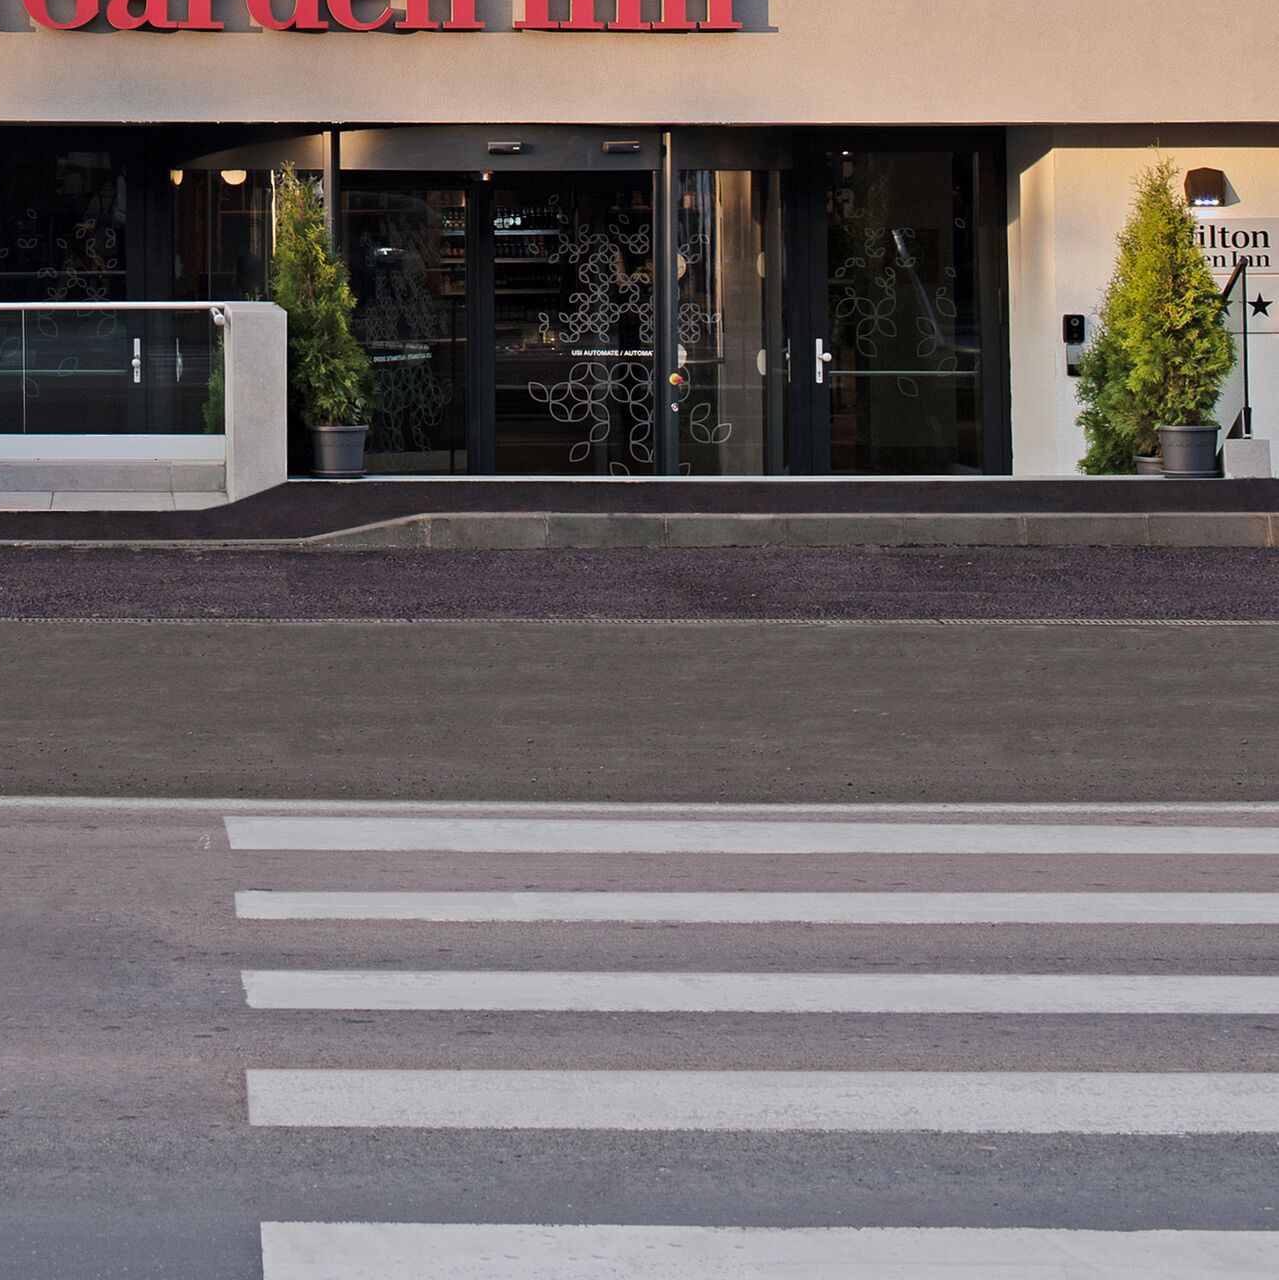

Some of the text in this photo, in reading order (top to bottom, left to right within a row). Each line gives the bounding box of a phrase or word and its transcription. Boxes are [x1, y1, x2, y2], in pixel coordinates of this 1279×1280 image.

[1197, 224, 1271, 249] ilton
[583, 349, 620, 357] AUTOMATE
[624, 349, 654, 357] AUTOMA
